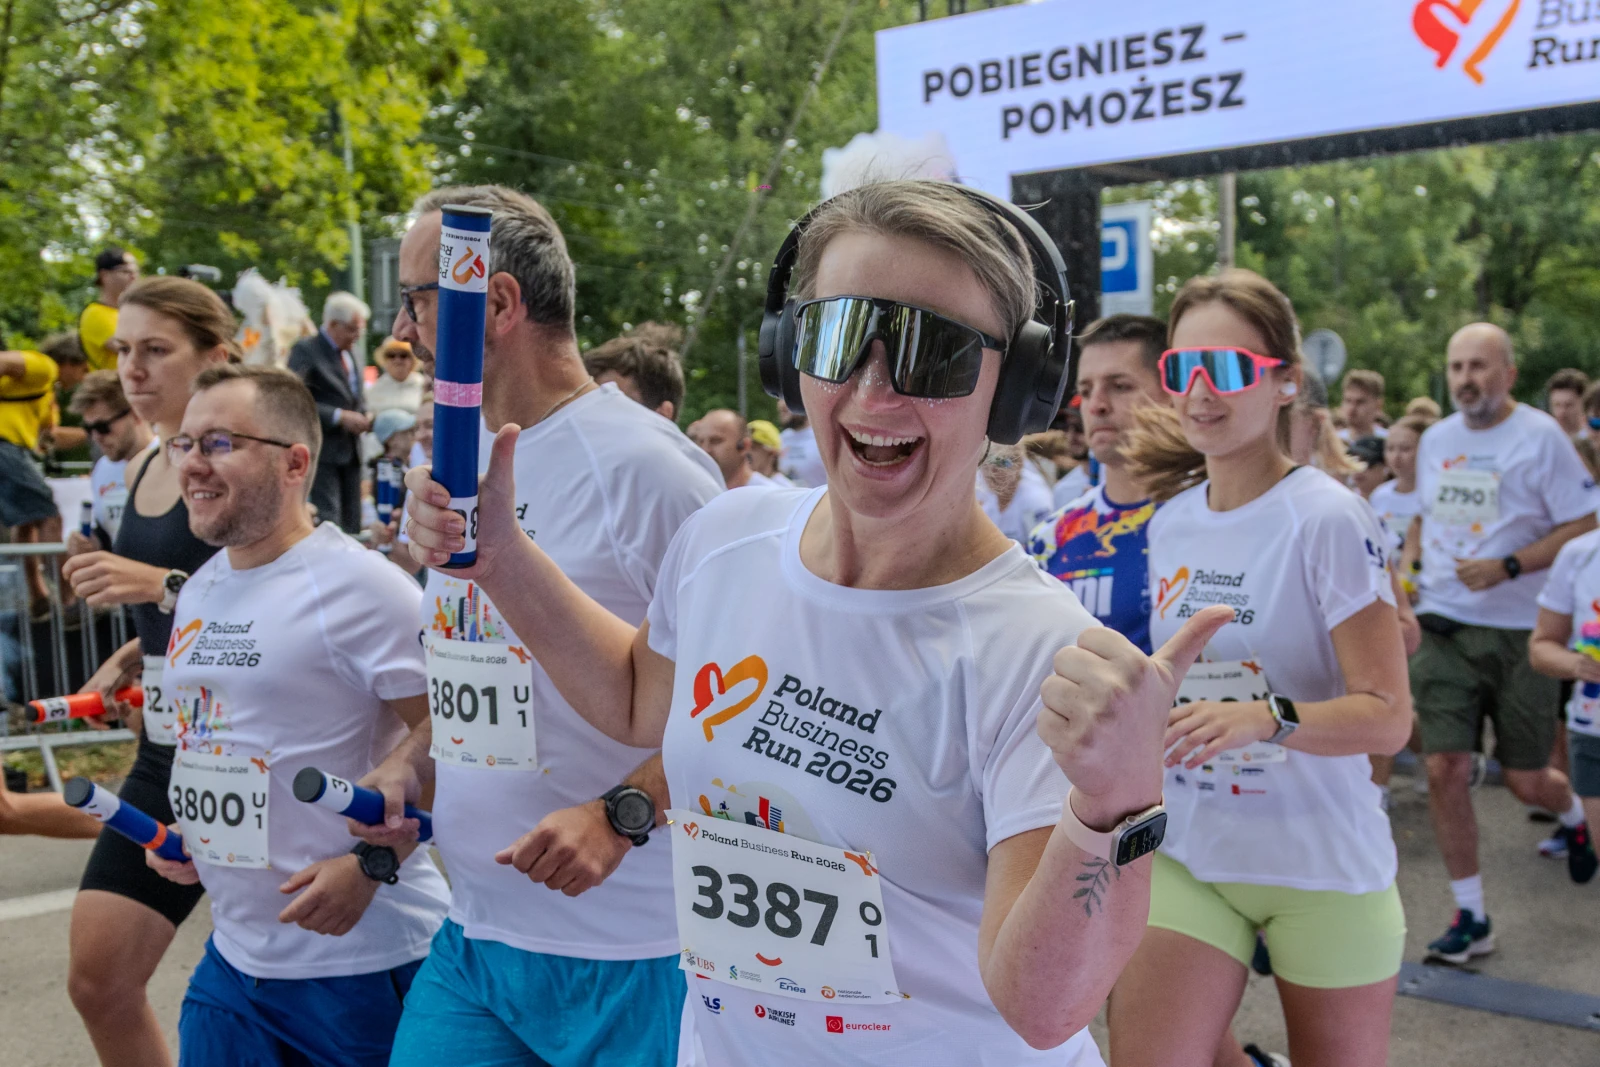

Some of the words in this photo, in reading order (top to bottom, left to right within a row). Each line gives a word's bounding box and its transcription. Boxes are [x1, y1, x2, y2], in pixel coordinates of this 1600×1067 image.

[1535, 0, 1600, 30] Bu
[922, 24, 1207, 103] POBIEGNIESZ
[1002, 71, 1246, 140] POMOŻESZ
[1191, 569, 1245, 587] Poland
[1184, 586, 1250, 607] Business
[1176, 603, 1198, 618] Ru
[1230, 608, 1255, 625] 26
[203, 620, 254, 634] Poland
[195, 635, 257, 650] Business
[186, 652, 215, 665] Run
[216, 652, 261, 667] 2026
[486, 656, 507, 664] 2026
[432, 677, 498, 726] 3801
[513, 685, 529, 704] U
[772, 673, 883, 734] Poland
[517, 710, 527, 728] 1
[758, 699, 890, 770] Business
[742, 726, 802, 768] Run
[804, 751, 898, 803] 2026
[173, 785, 245, 827] 3800
[252, 792, 266, 808] U
[255, 814, 263, 829] 1
[701, 829, 739, 847] Poland
[740, 839, 789, 858] Business
[790, 850, 814, 864] Run
[815, 857, 847, 872] 2026
[691, 865, 839, 947] 3387
[864, 933, 879, 958] 1
[696, 956, 715, 972] UBS
[779, 981, 806, 994] Enea
[767, 1007, 796, 1019] TURKISH
[768, 1014, 796, 1027] AIRLINES
[845, 1023, 891, 1031] euroclear
